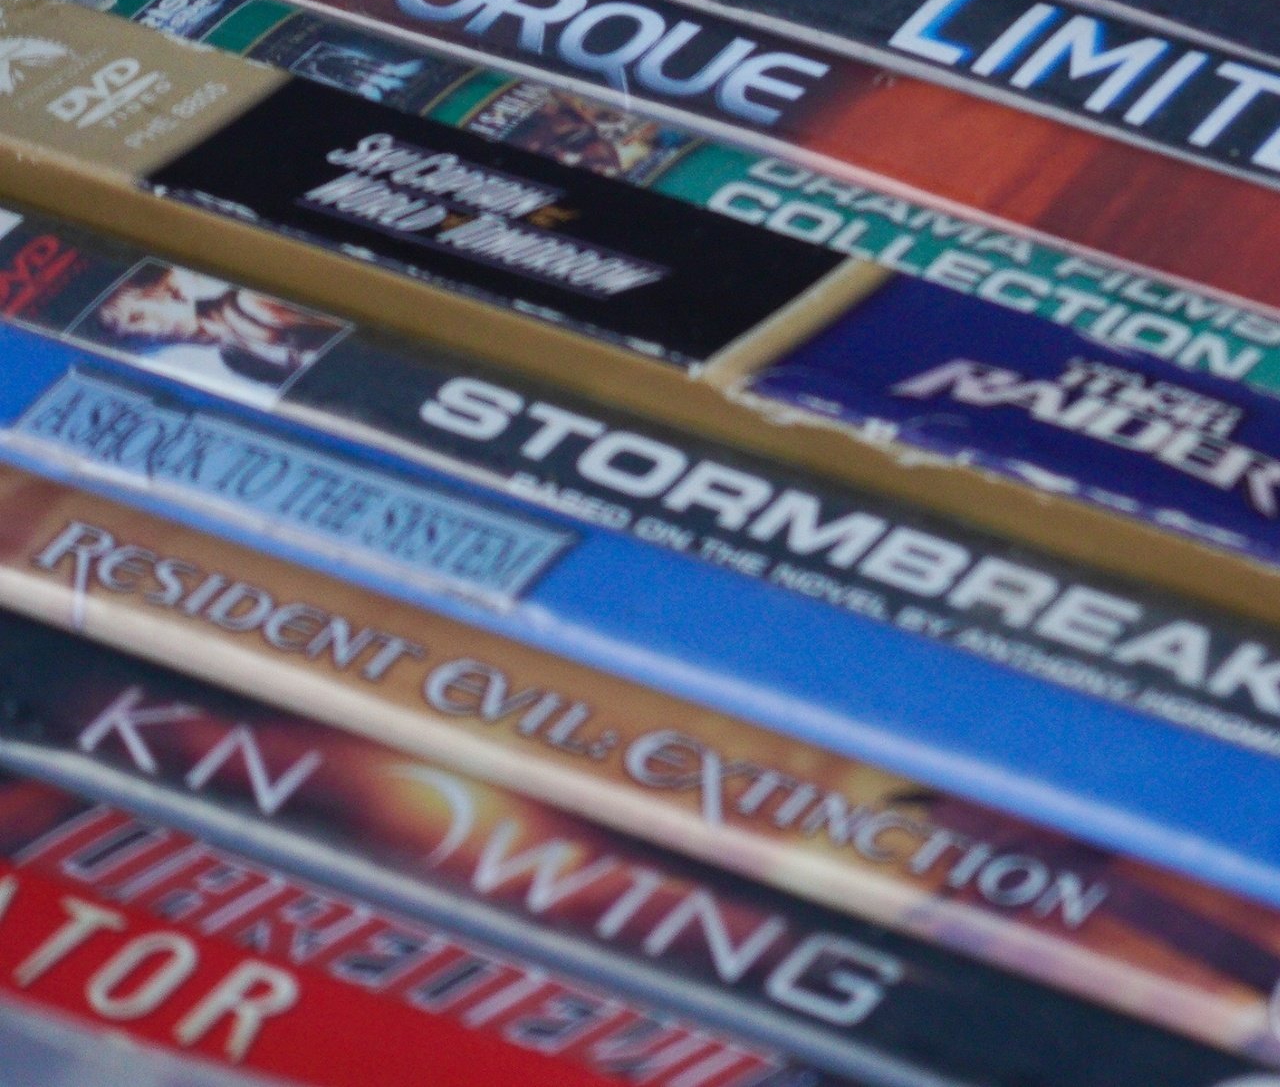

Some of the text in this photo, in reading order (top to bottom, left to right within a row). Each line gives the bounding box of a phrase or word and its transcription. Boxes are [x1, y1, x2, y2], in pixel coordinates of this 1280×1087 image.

[46, 57, 143, 126] DVD
[702, 181, 1264, 381] COLLECTION
[33, 517, 427, 687] RESIDENT
[621, 726, 1109, 931] EXTINCTION
